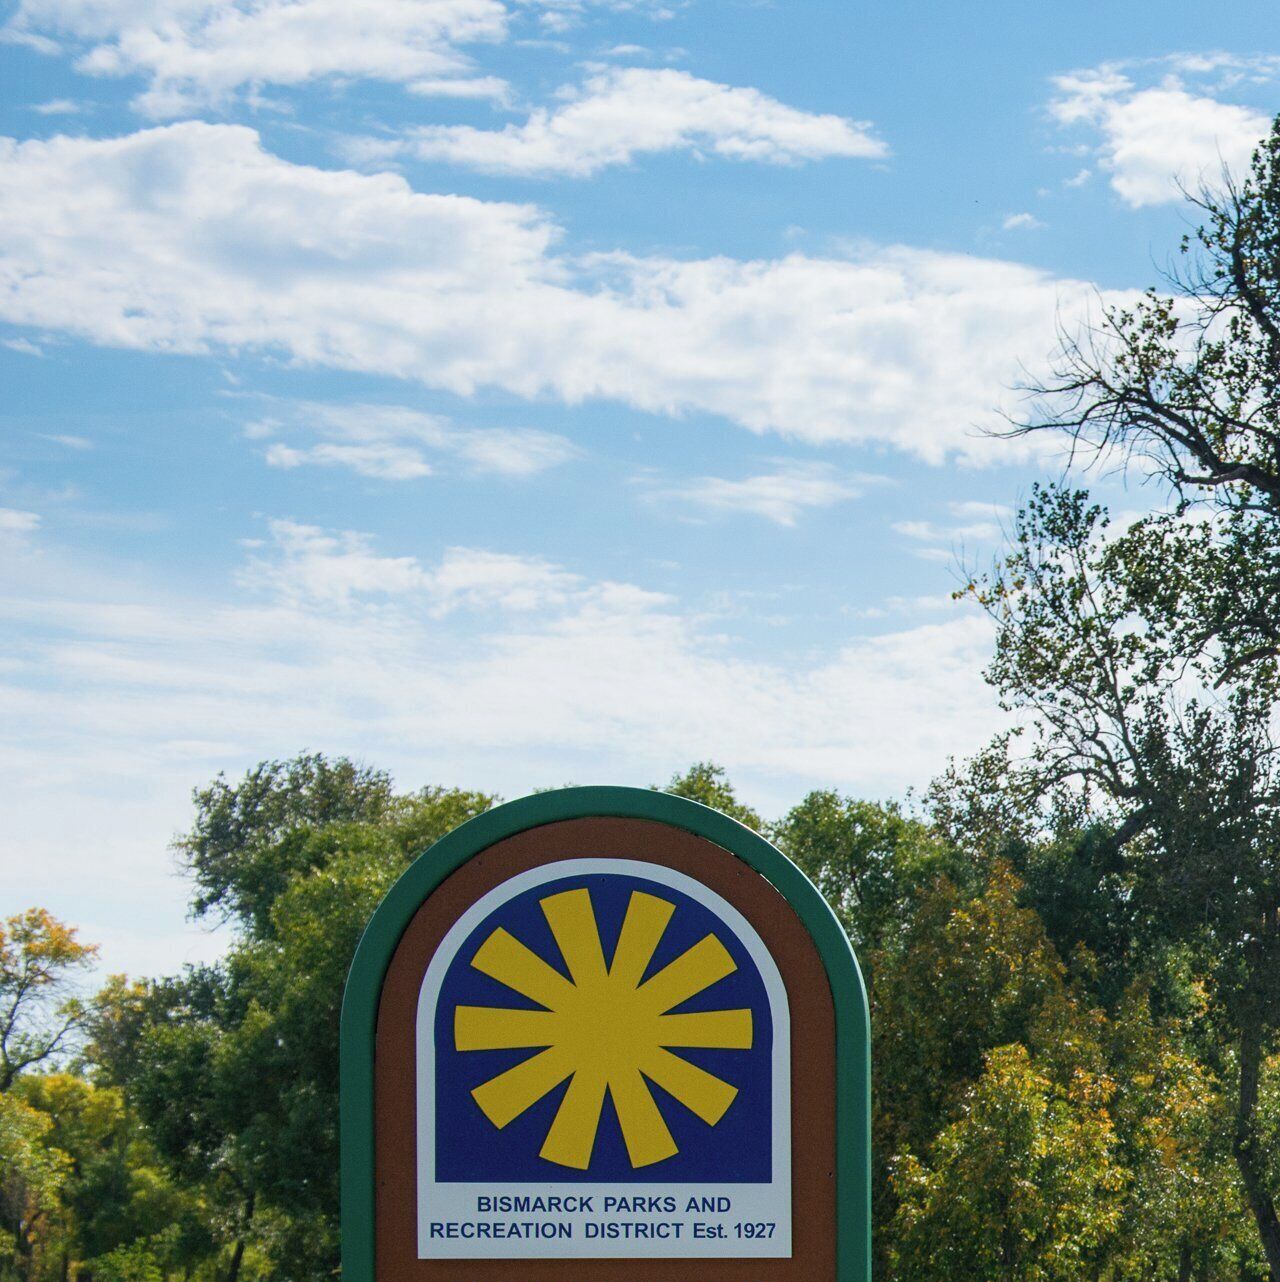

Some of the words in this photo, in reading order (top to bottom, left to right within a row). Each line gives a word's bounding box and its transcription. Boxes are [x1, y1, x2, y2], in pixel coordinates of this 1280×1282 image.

[478, 1196, 593, 1212] BISMARCK
[604, 1197, 676, 1213] PARKS
[685, 1197, 731, 1212] AND
[430, 1222, 572, 1238] RECREATION
[585, 1223, 684, 1239] DISTRICT
[693, 1223, 728, 1239] Est.
[734, 1223, 776, 1239] 1927
